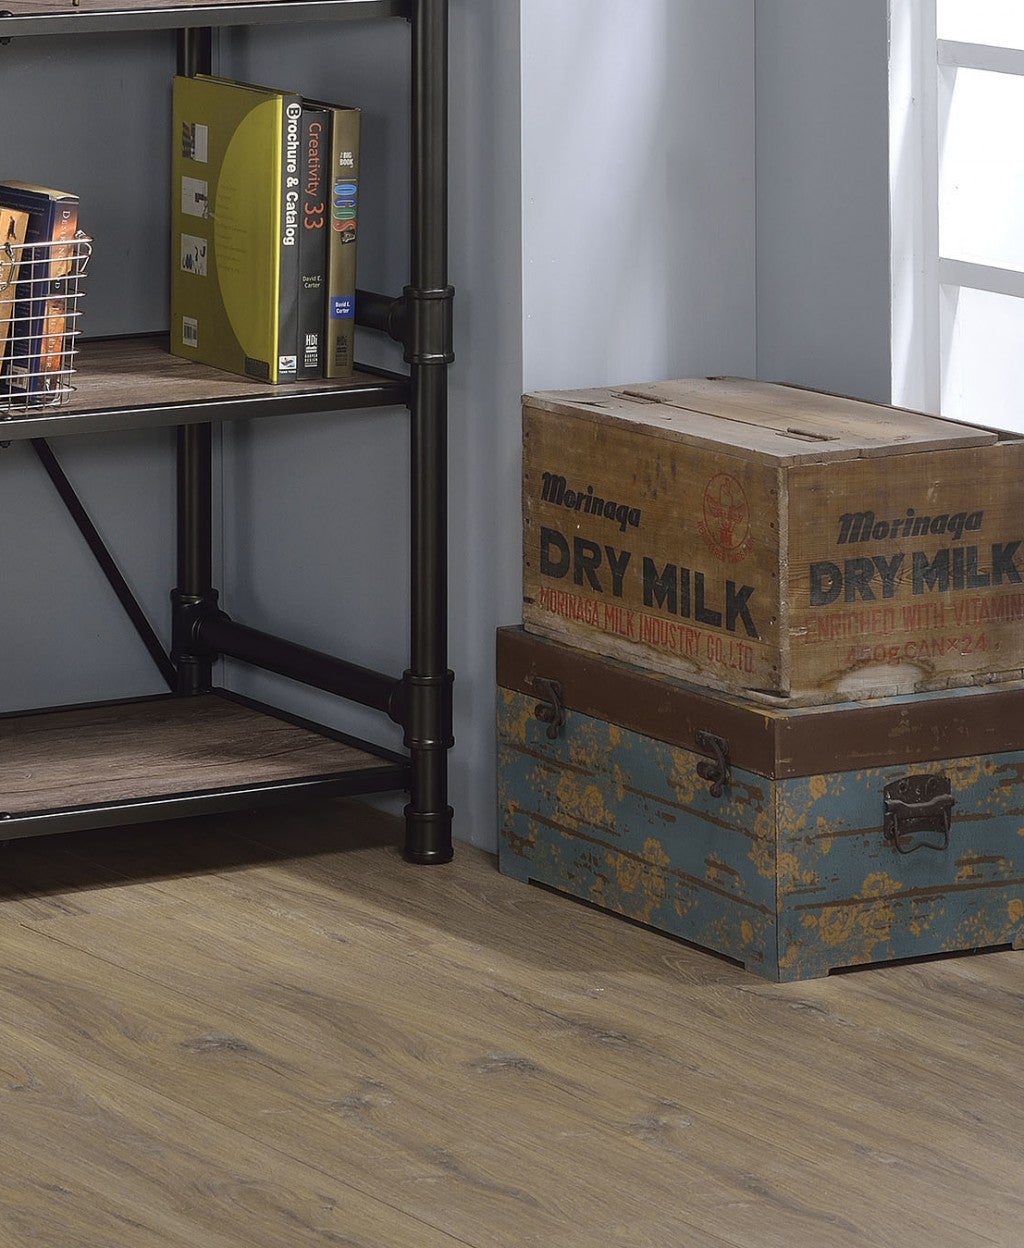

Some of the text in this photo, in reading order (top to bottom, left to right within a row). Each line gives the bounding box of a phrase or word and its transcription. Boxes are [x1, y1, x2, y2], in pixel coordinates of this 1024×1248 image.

[283, 102, 302, 246] Brochure & Catalog
[304, 122, 324, 230] Creativity 33
[540, 470, 642, 533] Morinaga
[837, 508, 984, 544] Morinaga
[539, 526, 632, 599] DRY
[643, 556, 759, 640] MILK
[809, 540, 1024, 607] DRY MILK
[540, 586, 600, 627] MORINAGA
[603, 603, 635, 638] MILK
[640, 613, 703, 657] INDUSTRY
[805, 607, 897, 645] ENRICHED
[902, 602, 946, 633] WITH
